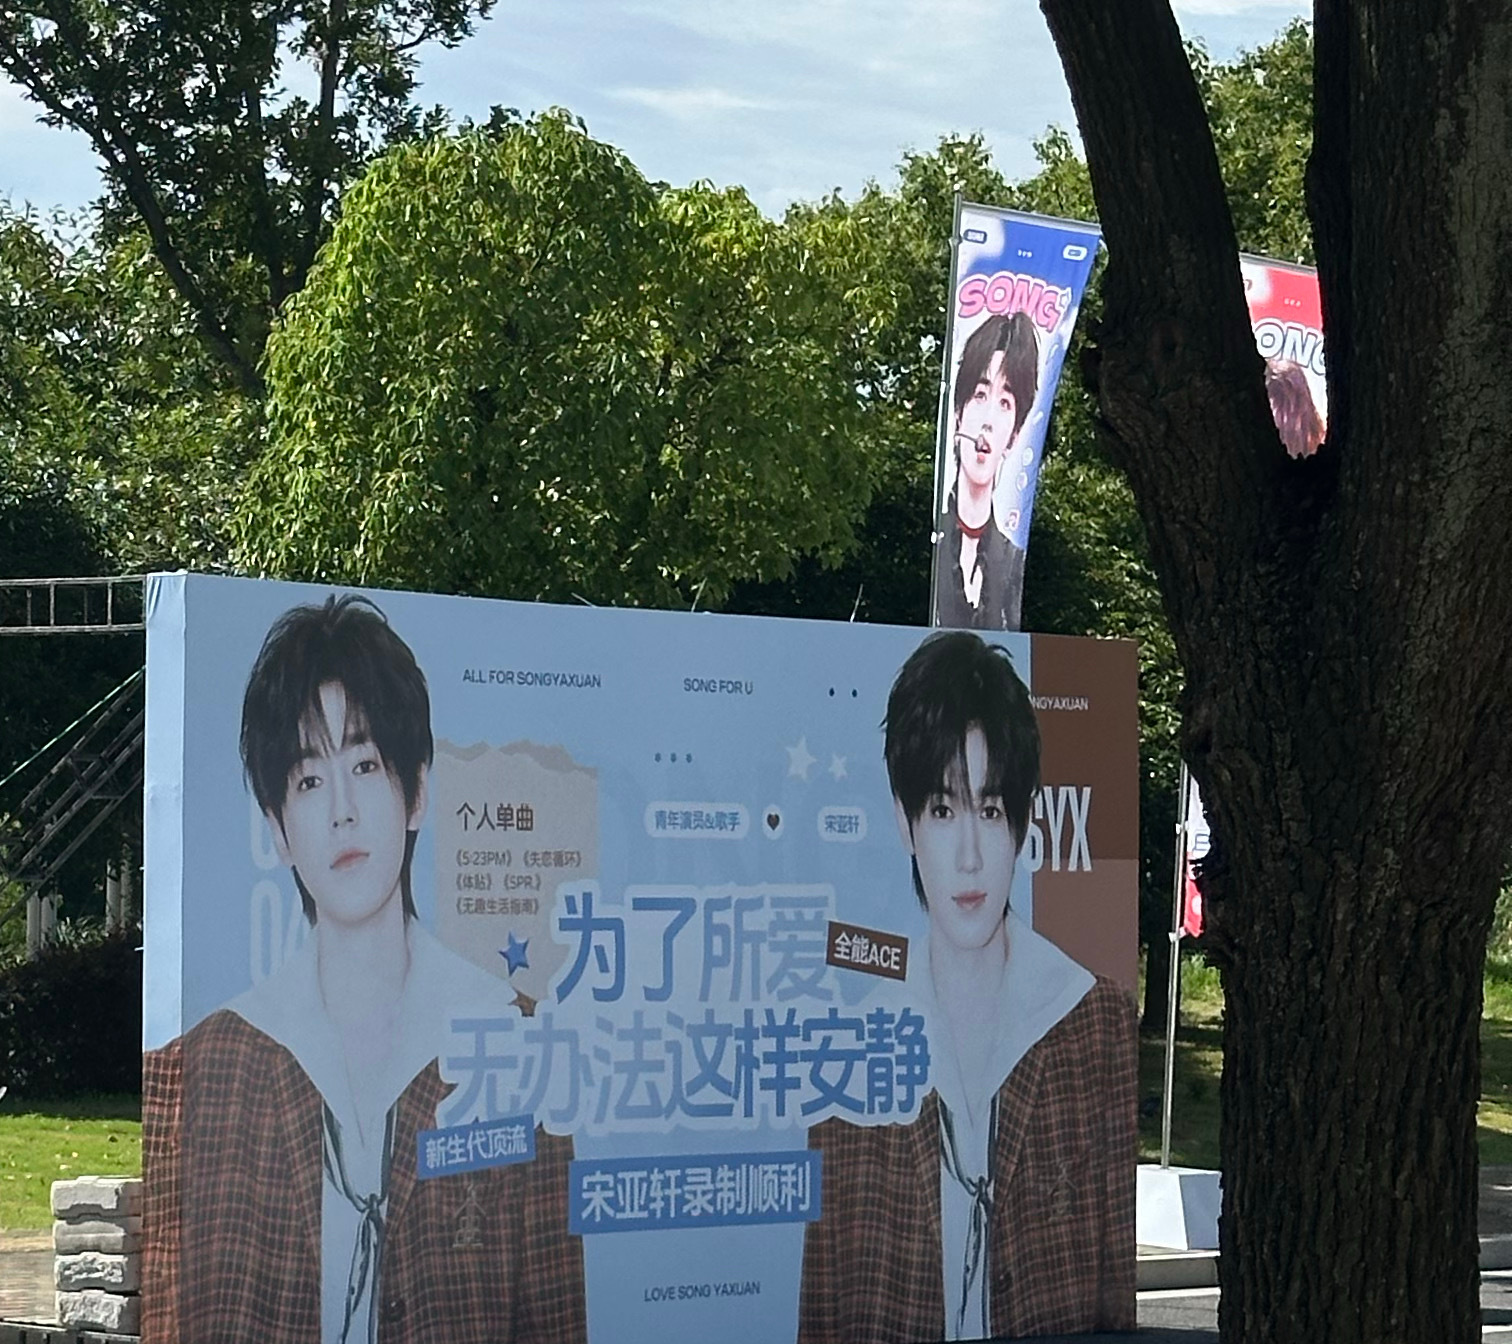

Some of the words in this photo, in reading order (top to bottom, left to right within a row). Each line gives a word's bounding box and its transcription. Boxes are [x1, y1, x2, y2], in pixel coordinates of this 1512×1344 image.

[958, 275, 1061, 334] SONG
[1254, 322, 1325, 376] ON
[462, 668, 487, 684] ALL
[489, 670, 515, 686] FOR
[517, 672, 602, 689] SONGYAXUAN
[683, 677, 718, 693] SONG
[719, 679, 743, 695] FOR
[744, 681, 754, 695] U
[1031, 694, 1089, 711] NGYAXUAN
[456, 801, 534, 832] 个人单曲
[824, 814, 860, 834] 宋亚轩
[556, 891, 834, 1005] 为了所爱
[832, 930, 902, 972] 全能ACE
[443, 1006, 931, 1125] 无办法这样安静
[425, 1123, 528, 1171] 新生代顶流
[581, 1160, 811, 1223] 宋亚轩录制顺利
[644, 1286, 676, 1302] LOVE
